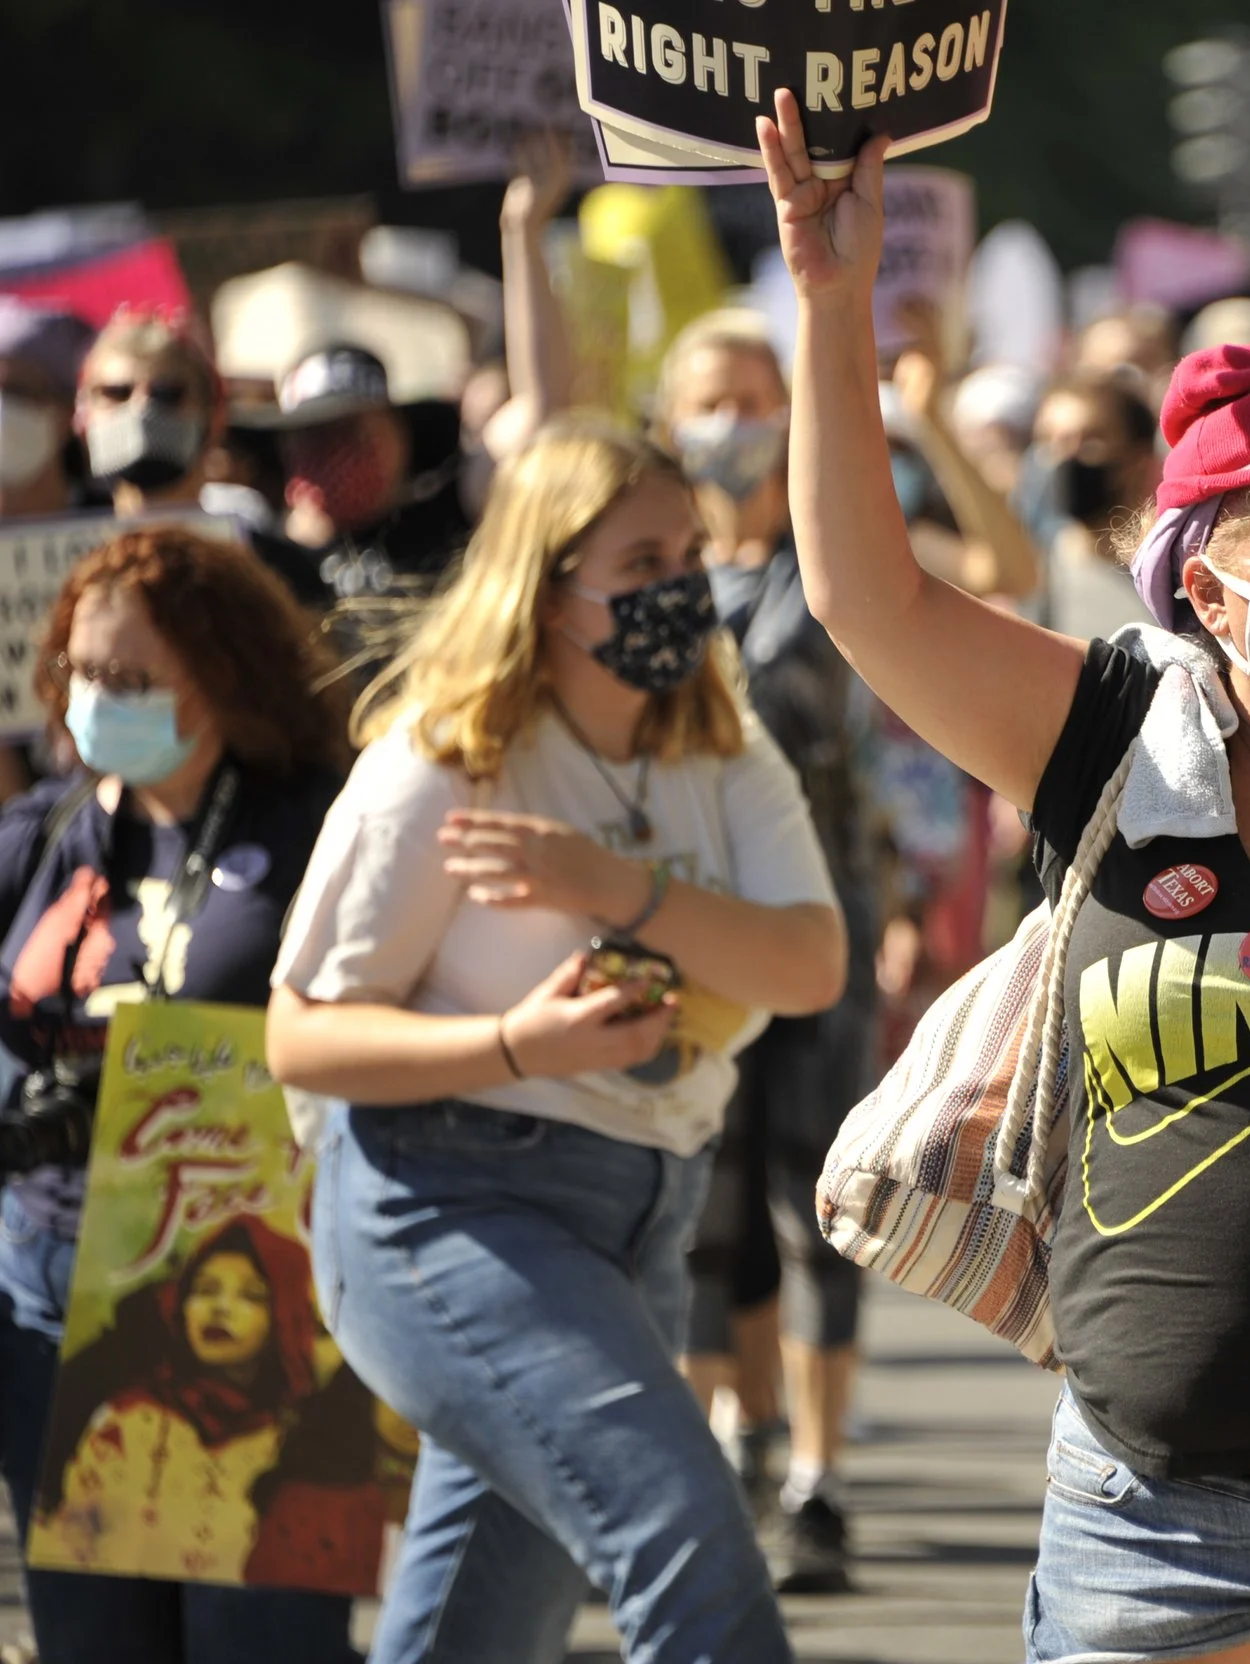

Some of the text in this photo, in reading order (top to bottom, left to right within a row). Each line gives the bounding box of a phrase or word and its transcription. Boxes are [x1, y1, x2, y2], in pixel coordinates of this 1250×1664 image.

[598, 2, 991, 112] RIGHT REASON
[1177, 864, 1215, 896] ABORT
